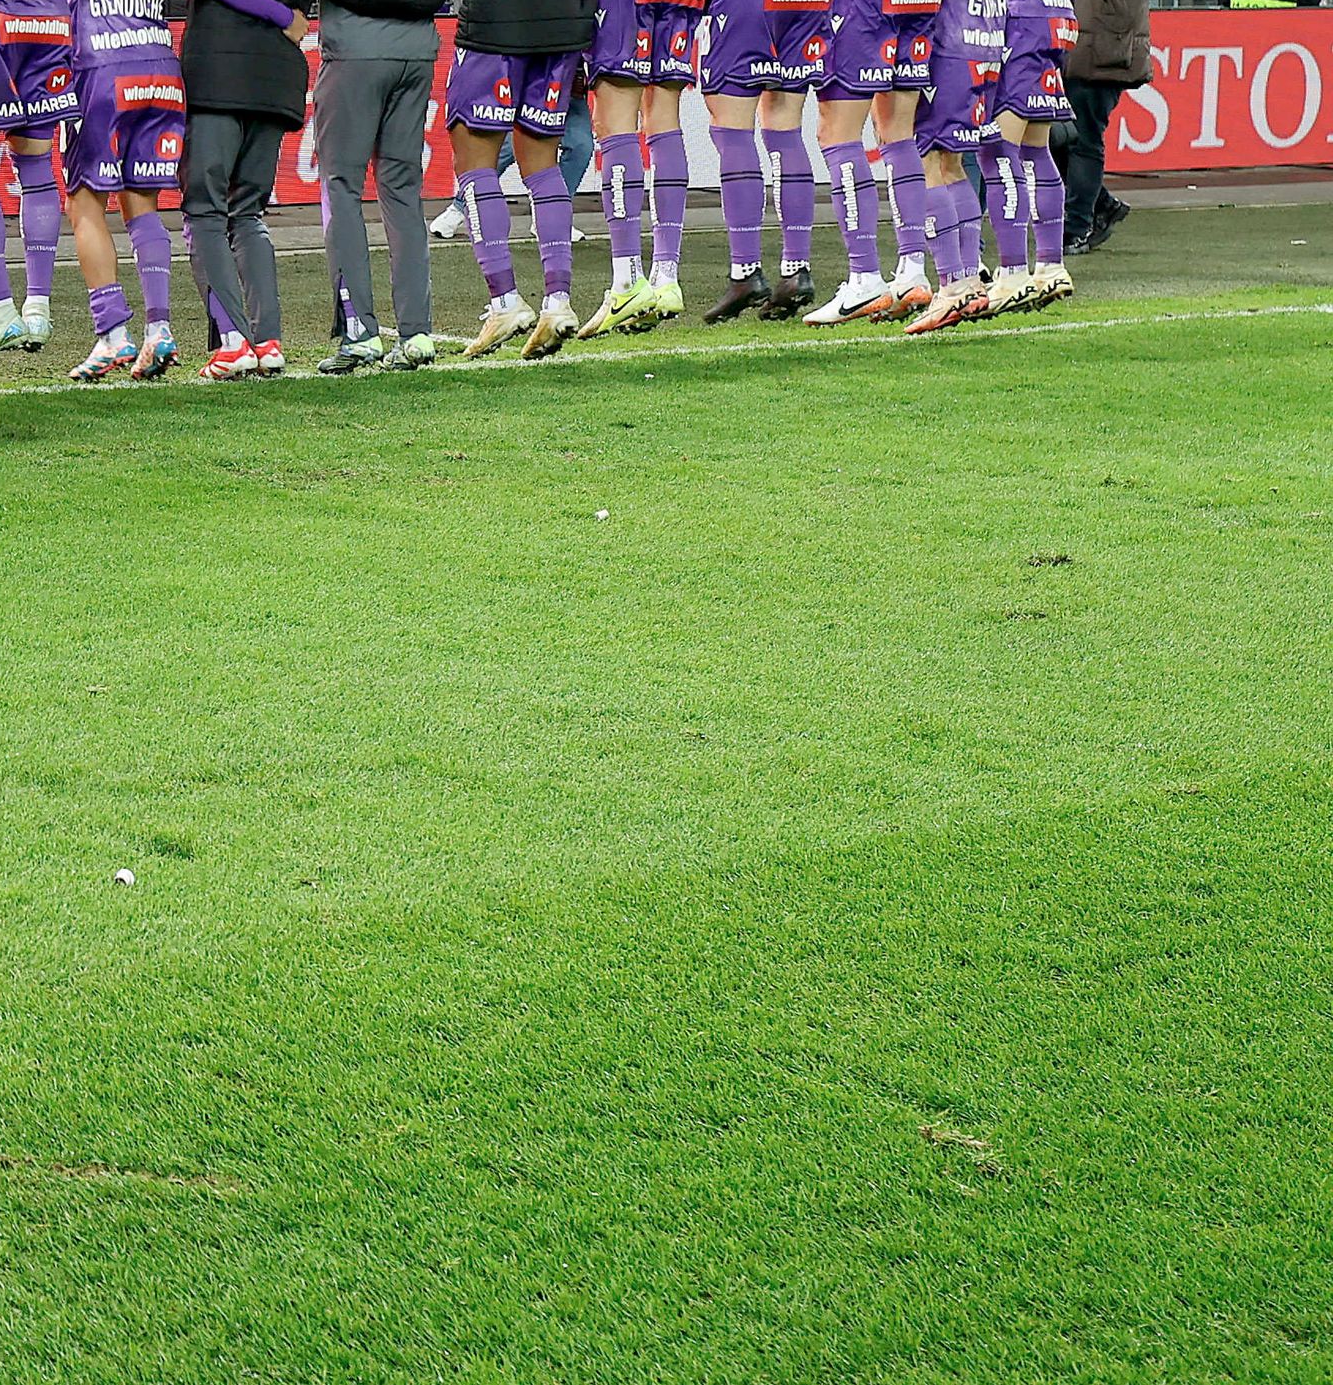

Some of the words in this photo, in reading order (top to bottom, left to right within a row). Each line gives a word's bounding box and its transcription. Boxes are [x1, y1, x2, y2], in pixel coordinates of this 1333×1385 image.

[4, 19, 70, 37] wienholding
[808, 48, 820, 61] M
[914, 41, 925, 56] M
[51, 74, 65, 88] M
[547, 88, 561, 103] M
[1116, 42, 1333, 155] STO
[161, 139, 177, 155] M
